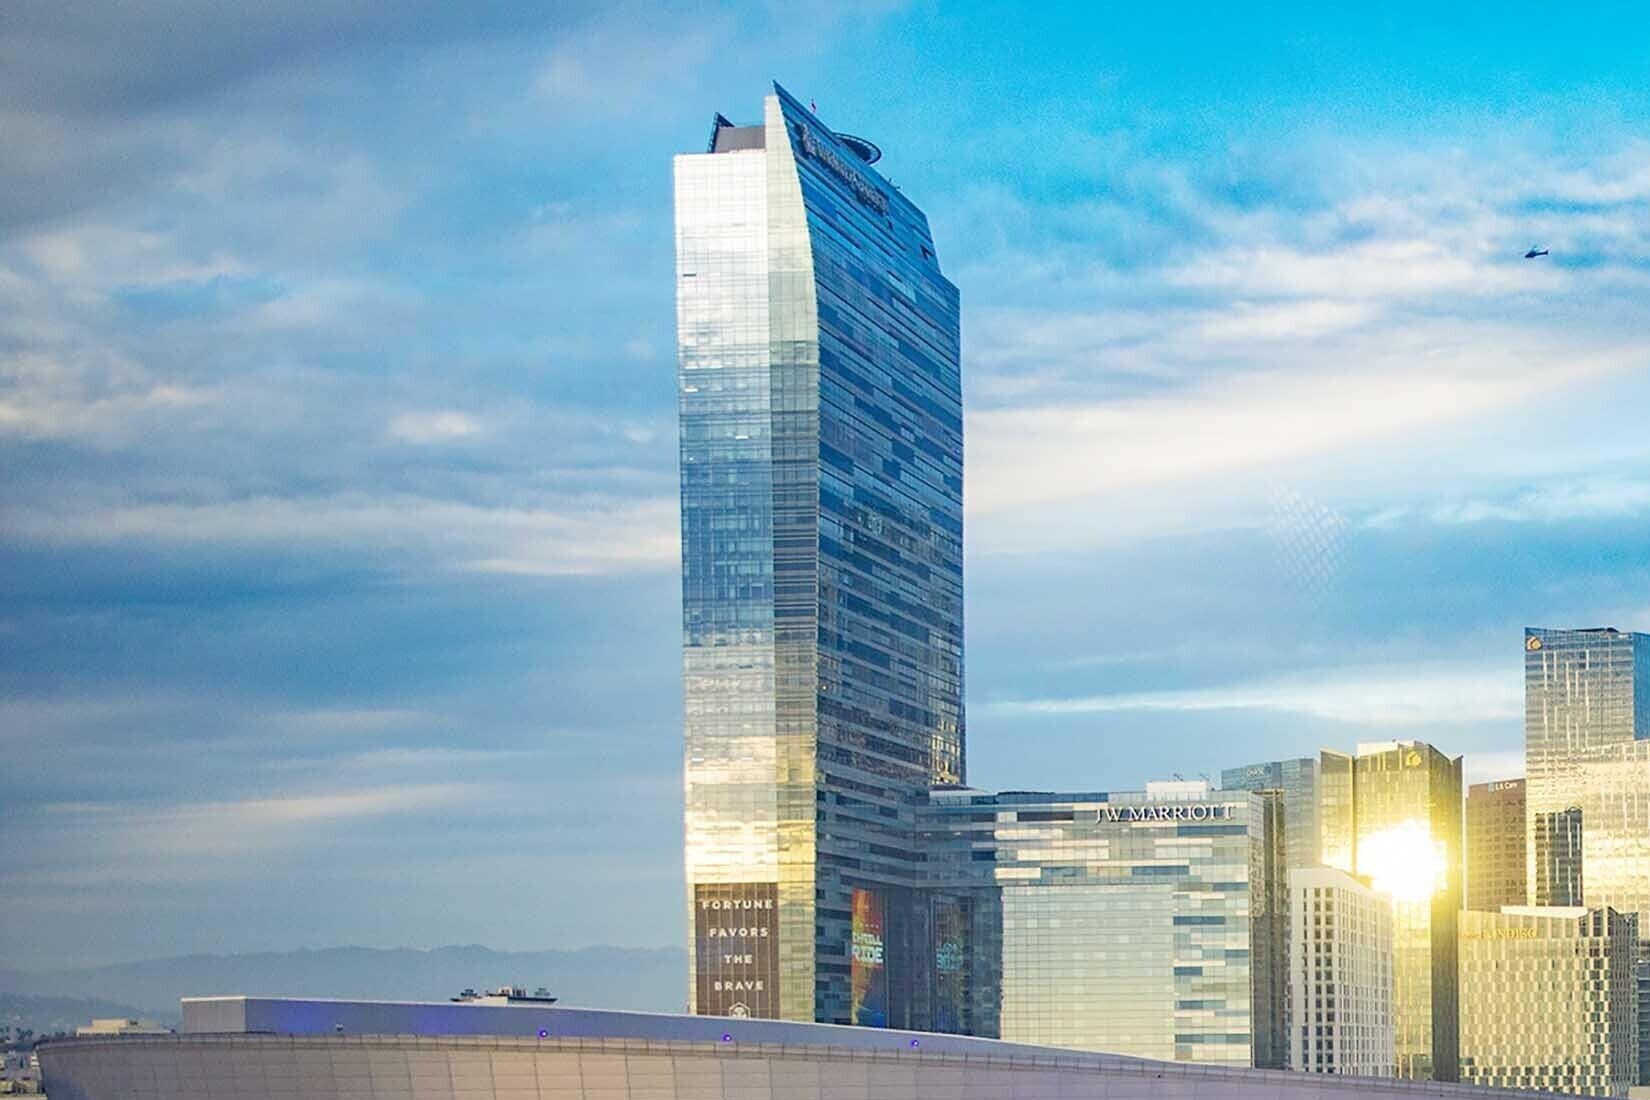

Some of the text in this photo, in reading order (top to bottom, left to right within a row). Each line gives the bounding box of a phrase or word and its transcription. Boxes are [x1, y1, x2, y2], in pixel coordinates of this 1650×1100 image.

[1096, 804, 1235, 824] JW MARRIOTT
[702, 900, 773, 910] FORTUNE
[709, 928, 769, 937] FAVORS
[724, 954, 753, 964] THE
[714, 981, 764, 991] BRAVE
